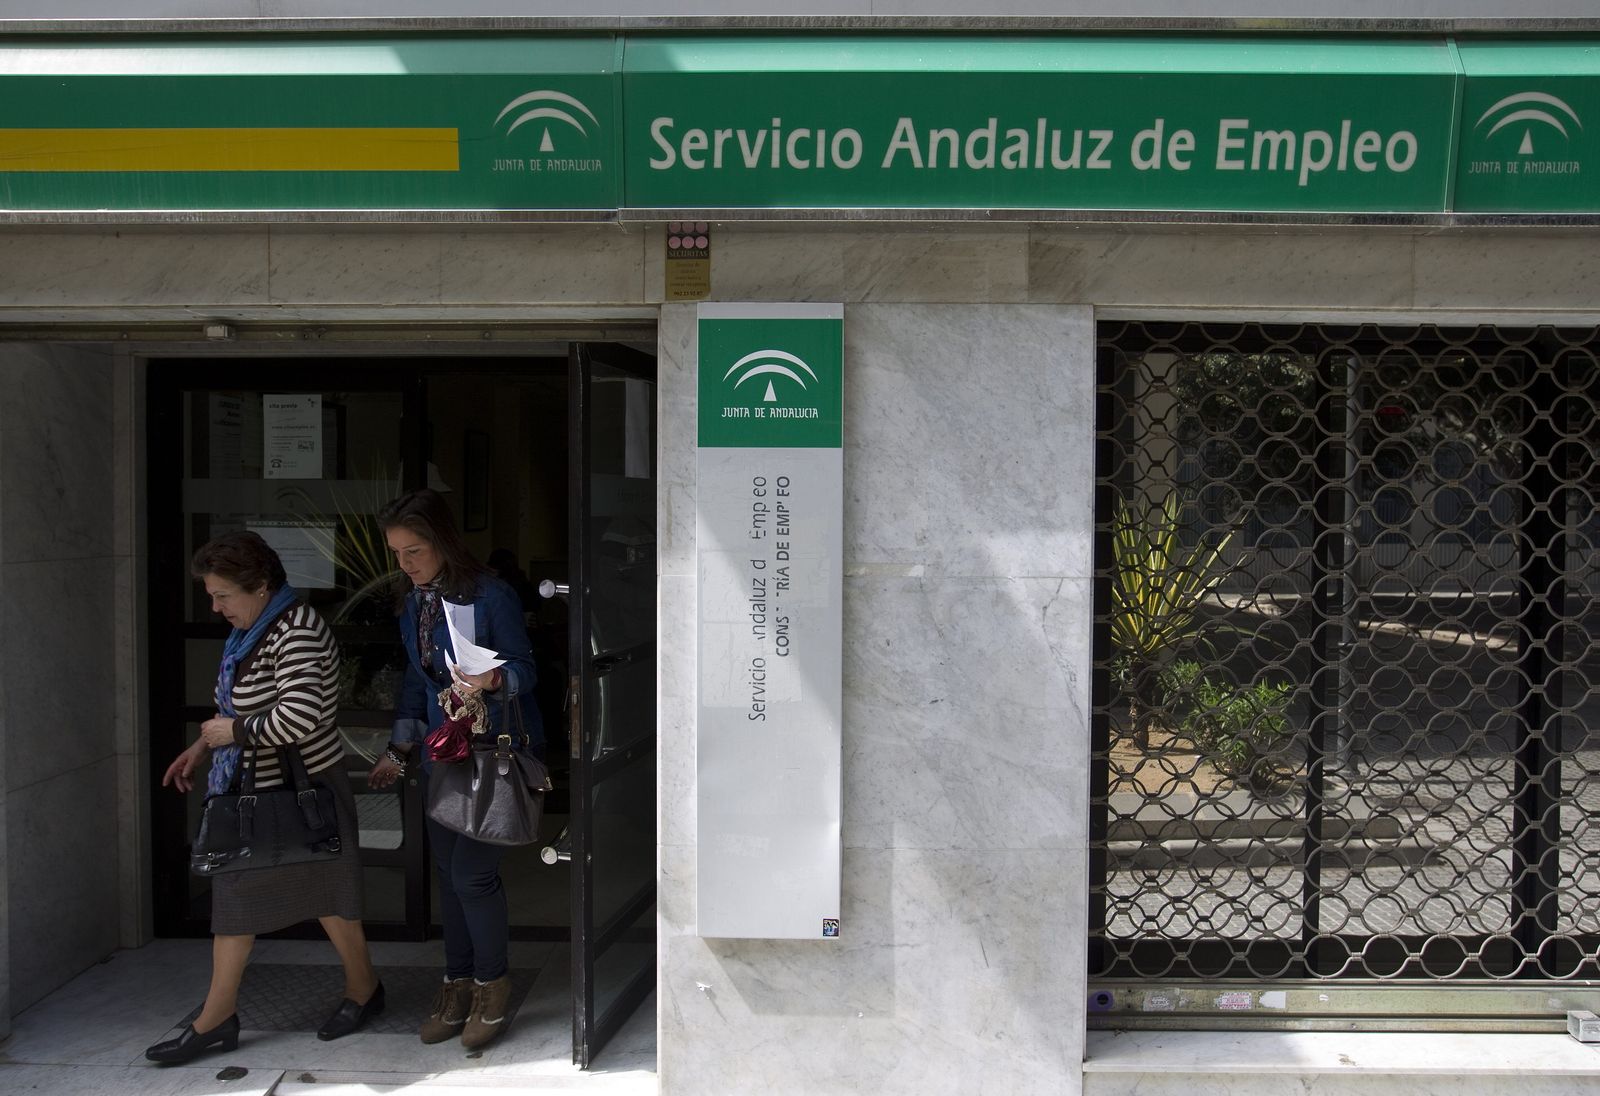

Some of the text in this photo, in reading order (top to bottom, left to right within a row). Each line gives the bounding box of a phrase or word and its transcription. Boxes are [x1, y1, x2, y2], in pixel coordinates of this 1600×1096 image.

[492, 159, 602, 172] JUNTA DE ANDALUCIA
[650, 117, 1418, 187] Servicio Andaluz de Empleo
[1468, 161, 1580, 174] JUNTA DE ANDALUCIA
[721, 407, 819, 419] JUNTA DE ANDALUCIA
[748, 476, 771, 541] Empeo
[776, 476, 790, 536] EMPEO
[776, 541, 790, 561] DE
[748, 657, 766, 722] Servicio
